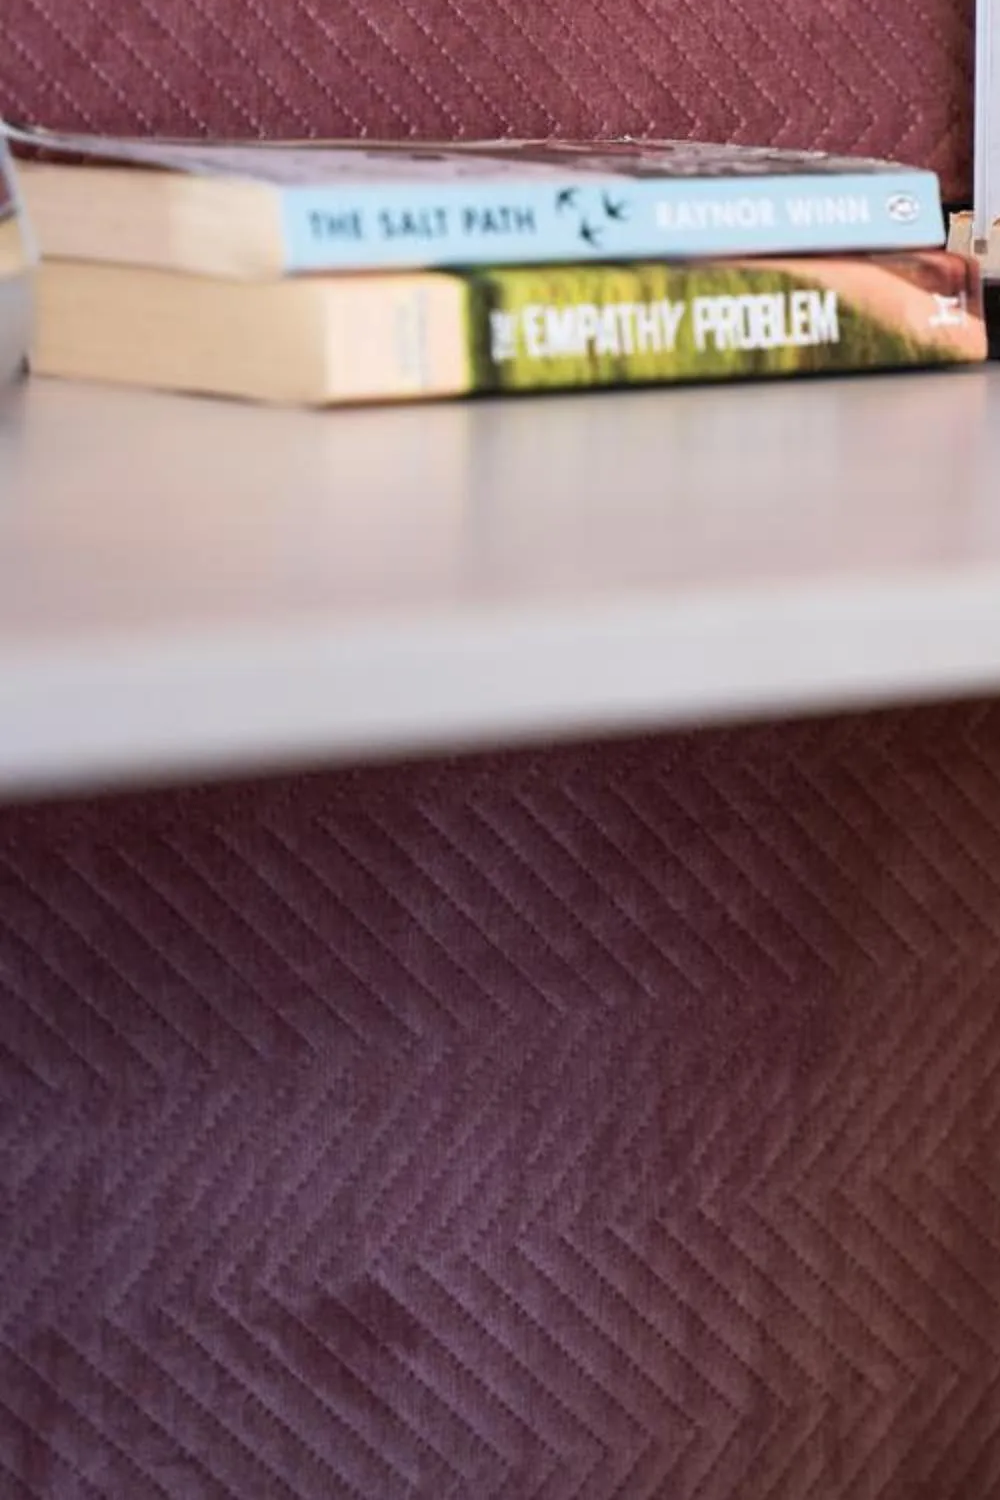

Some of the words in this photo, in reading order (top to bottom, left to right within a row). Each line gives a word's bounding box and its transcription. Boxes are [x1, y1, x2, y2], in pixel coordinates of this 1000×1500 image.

[308, 209, 363, 242] THE
[378, 207, 447, 241] SALT
[461, 205, 538, 236] PATH
[655, 198, 776, 230] RAYNOR
[785, 194, 871, 225] WINN
[522, 299, 686, 360] EMPATHY
[692, 290, 840, 354] PROBLEM
